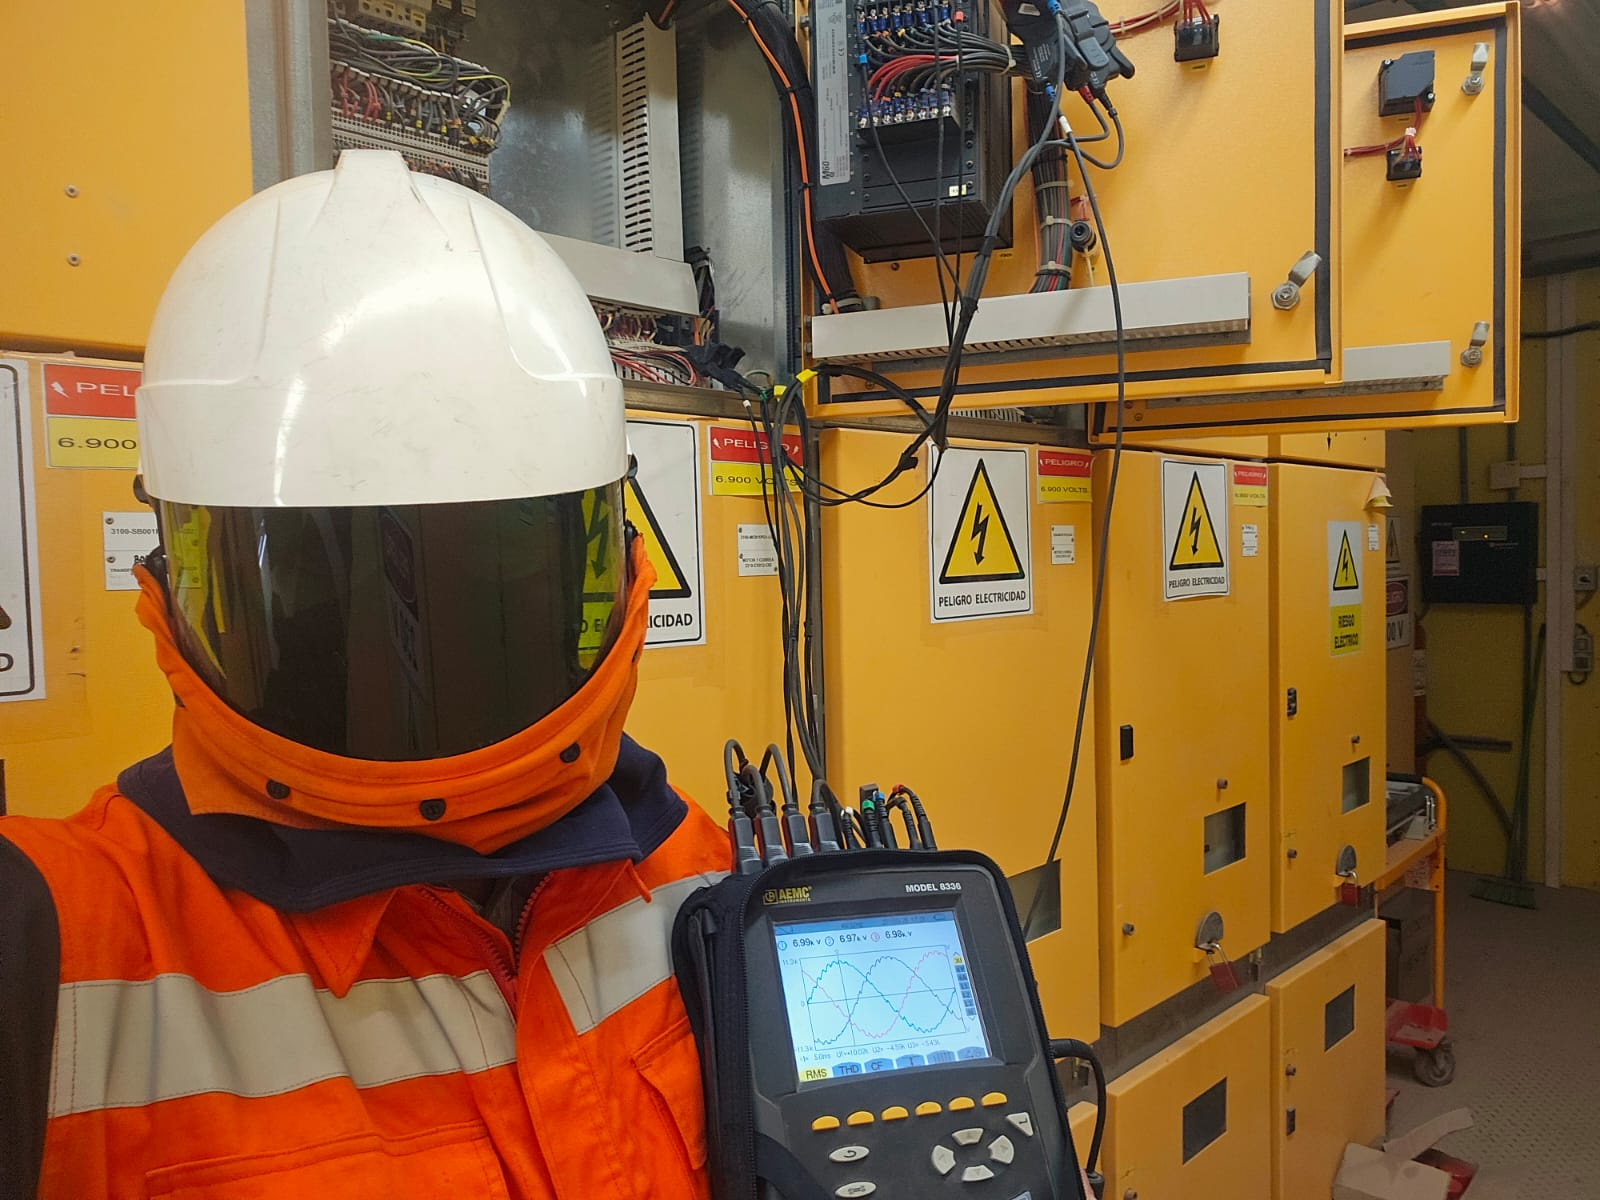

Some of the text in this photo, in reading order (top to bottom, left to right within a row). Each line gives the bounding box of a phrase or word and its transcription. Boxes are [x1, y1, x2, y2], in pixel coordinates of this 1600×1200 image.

[58, 436, 138, 450] 6.900
[1045, 458, 1085, 467] PELIGRO
[715, 475, 752, 484] 6.900
[1063, 486, 1088, 494] VOLTS
[1169, 575, 1225, 589] PELIGRO ELECTRICIDAD
[939, 590, 1026, 608] PELIGRO ELECTRICIDAD
[905, 883, 938, 893] MODEL
[806, 1068, 828, 1079] RMS
[838, 1064, 859, 1074] THD
